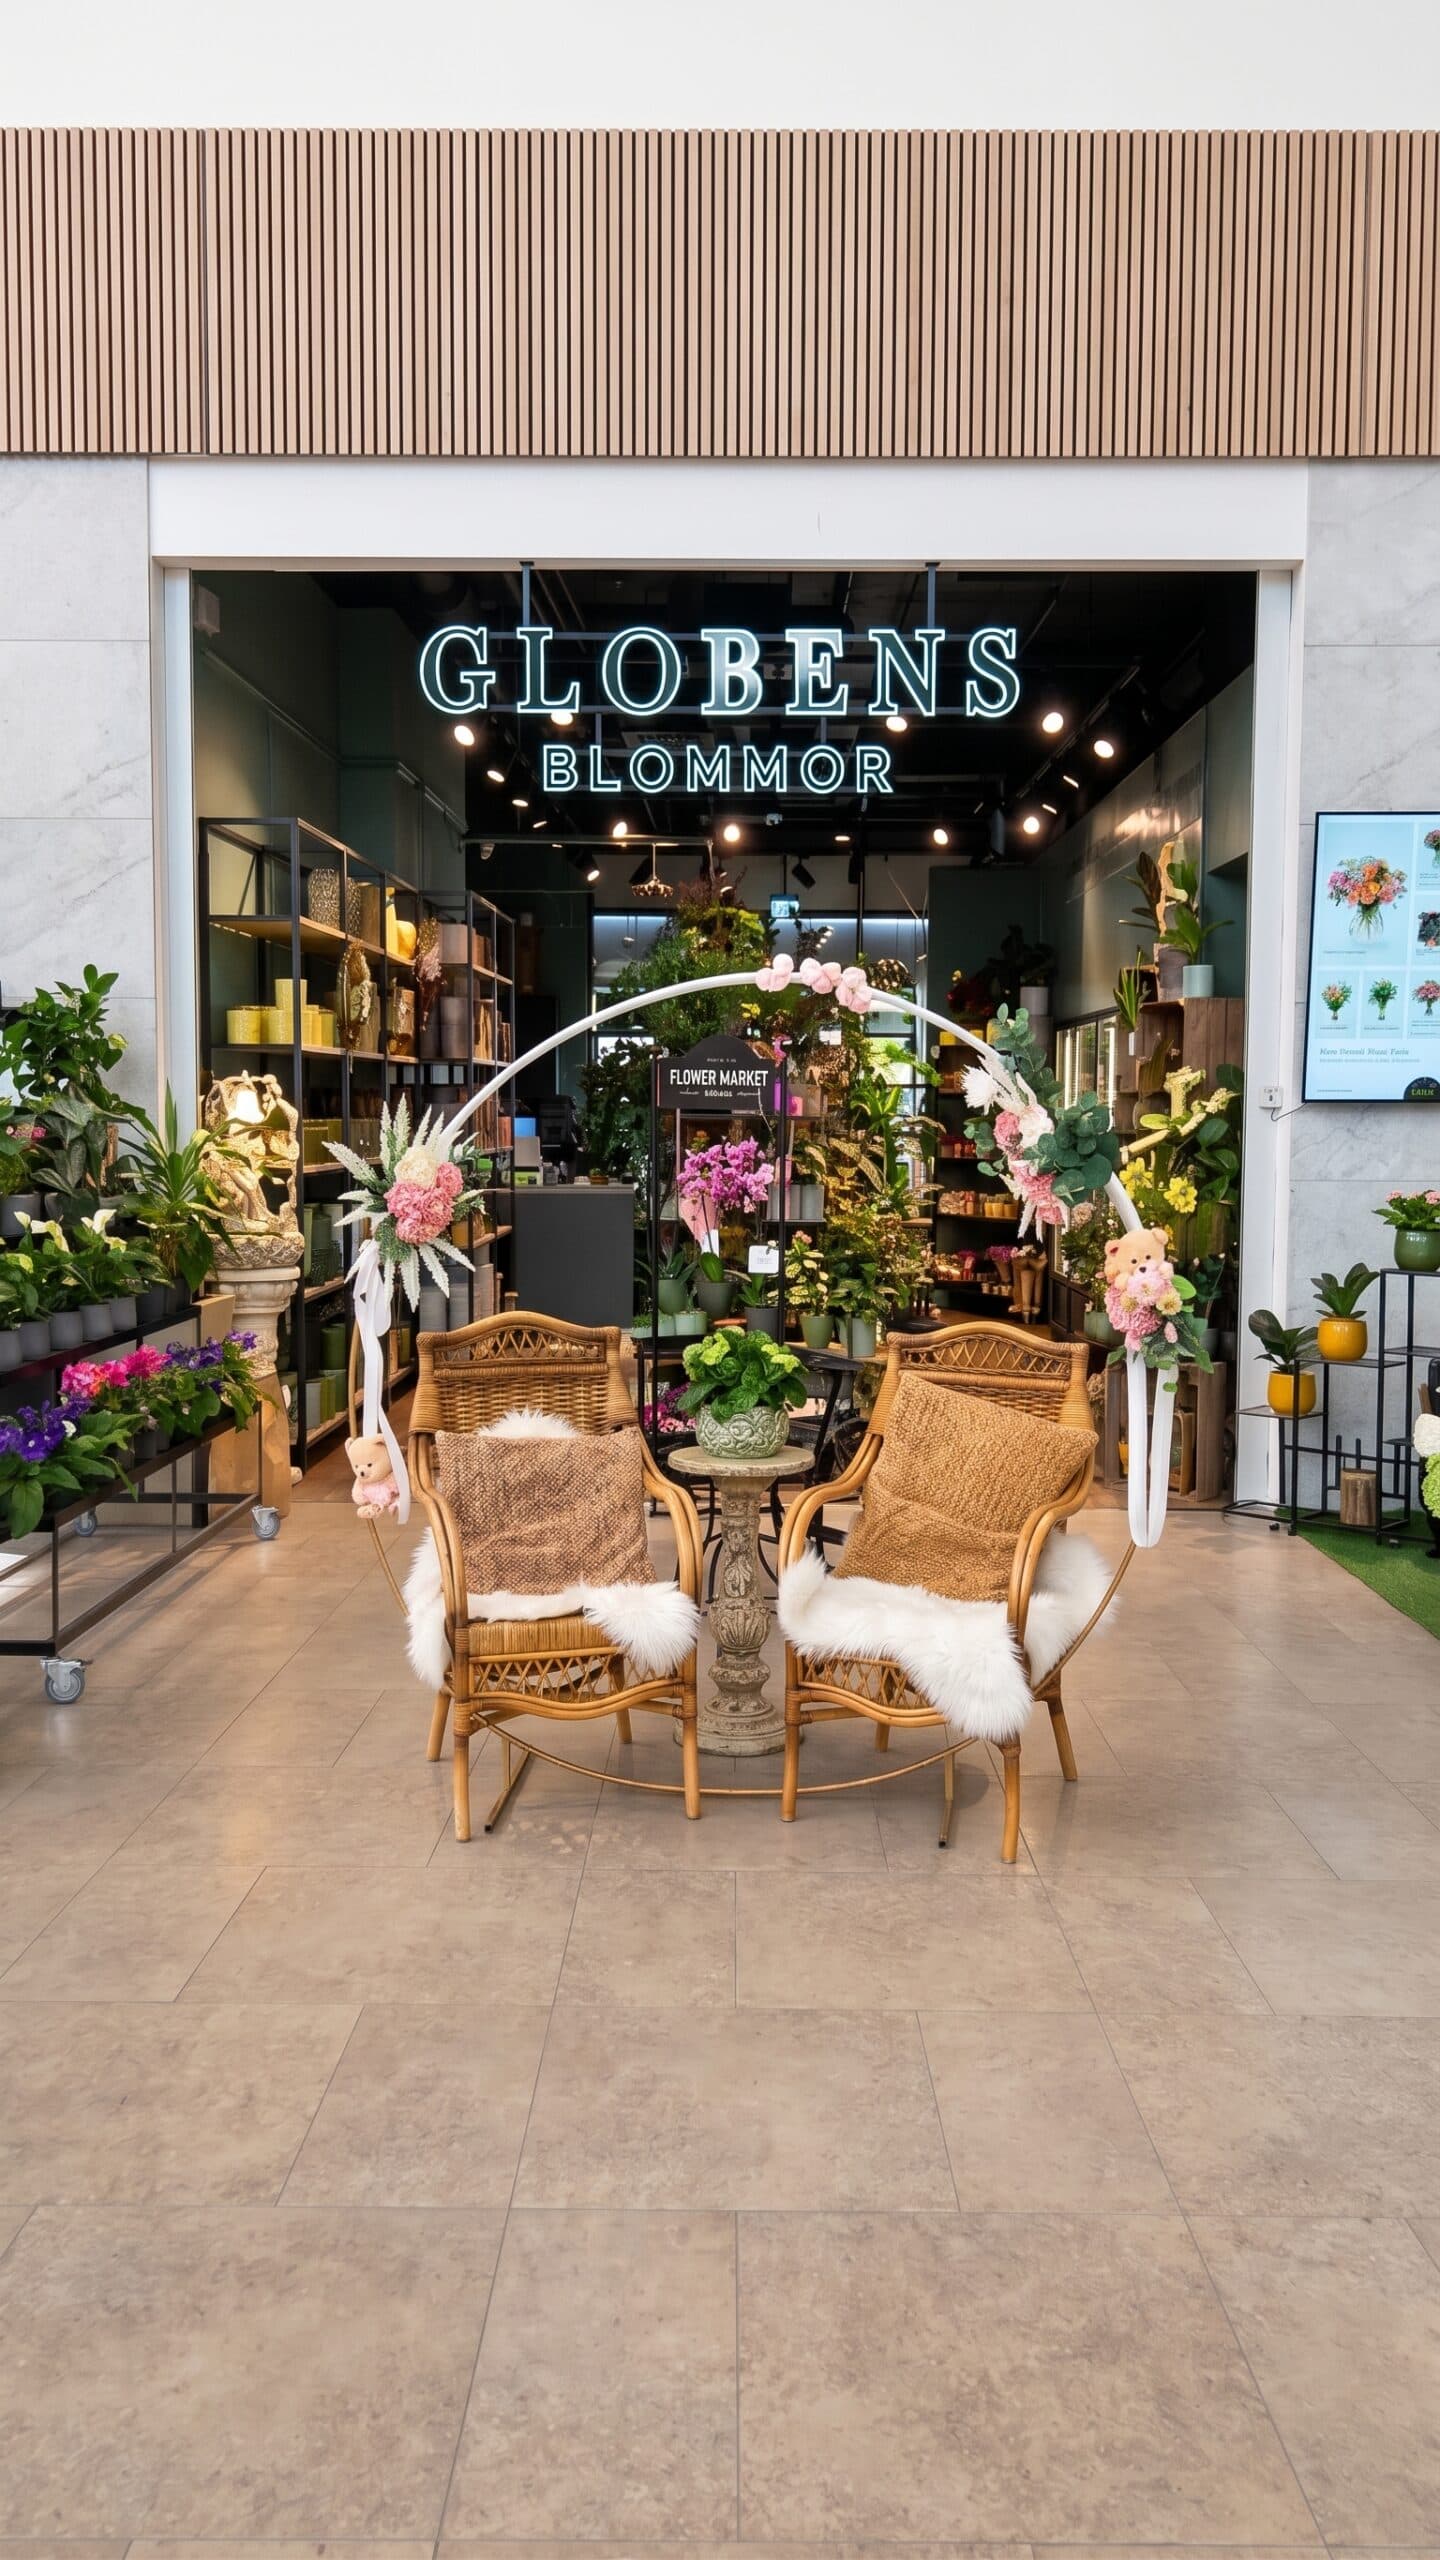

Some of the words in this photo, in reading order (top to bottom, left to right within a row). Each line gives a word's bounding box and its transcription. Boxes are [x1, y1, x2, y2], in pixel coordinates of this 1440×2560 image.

[418, 625, 1021, 719] GLOBENS
[541, 743, 895, 795] BLOMMOR
[669, 1068, 716, 1086] FLOWER
[719, 1069, 769, 1087] MARKET
